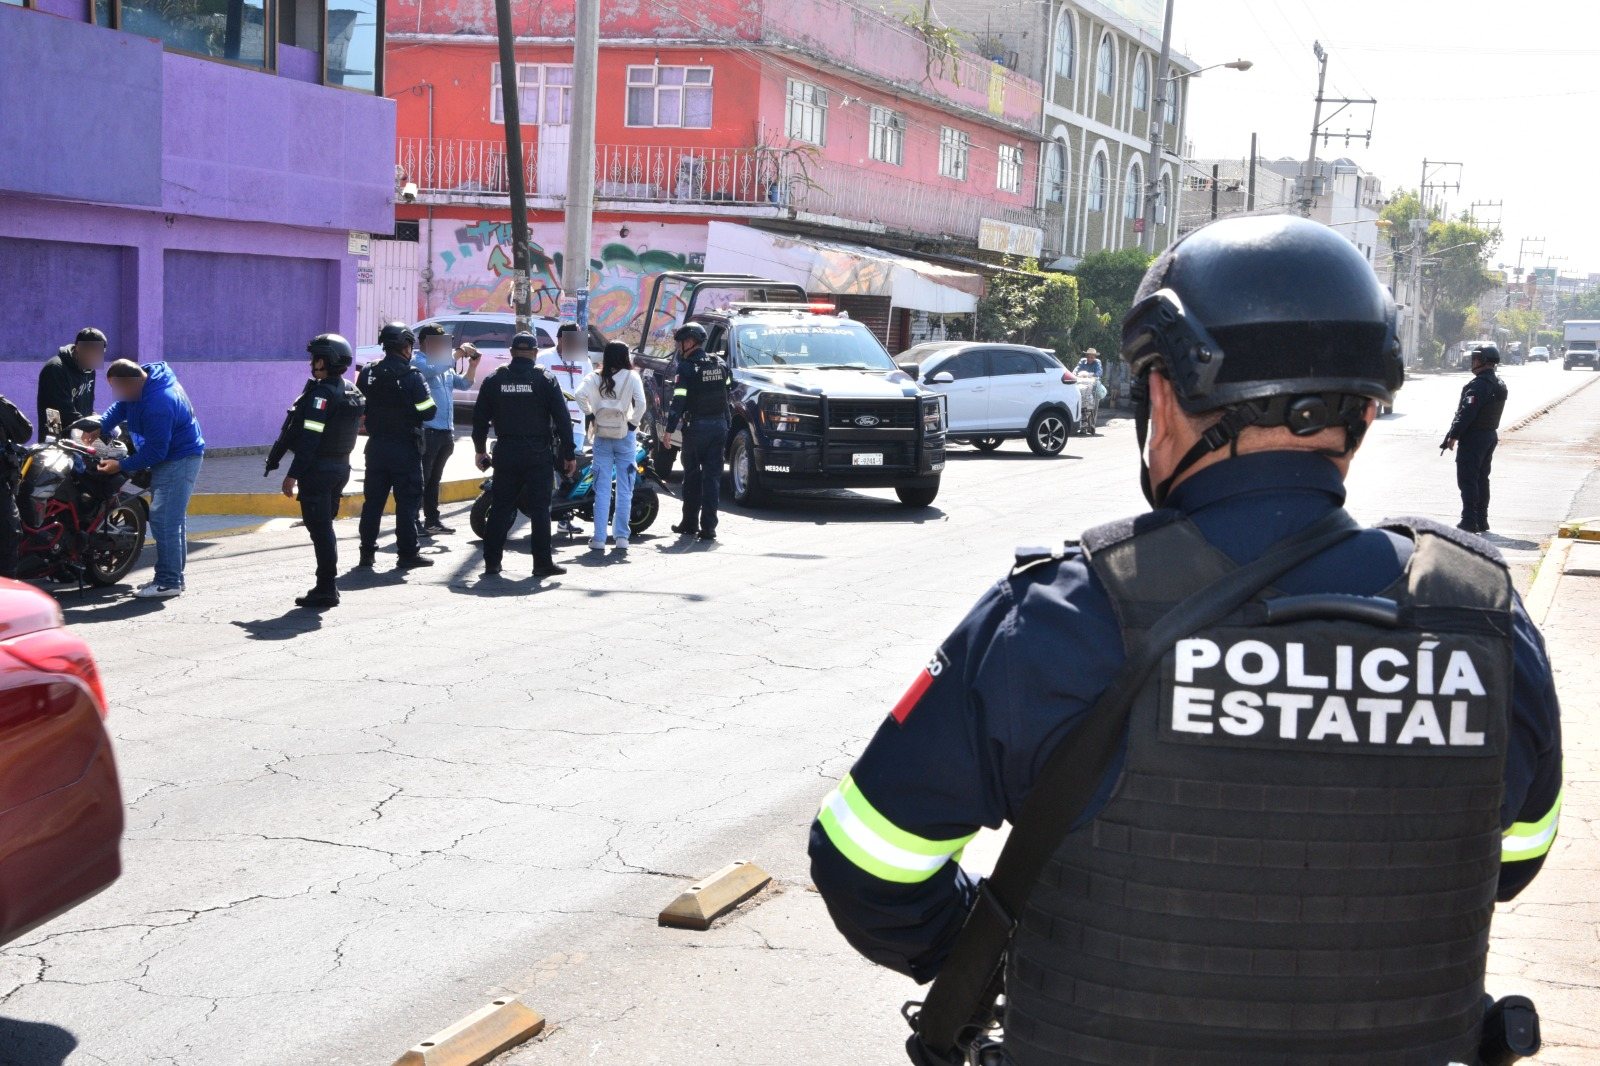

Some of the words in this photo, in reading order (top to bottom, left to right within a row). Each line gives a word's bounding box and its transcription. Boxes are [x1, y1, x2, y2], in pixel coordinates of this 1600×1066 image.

[764, 465, 790, 473] ME924A5
[1174, 637, 1487, 697] POLICÍA
[1171, 685, 1486, 747] ESTATAL
